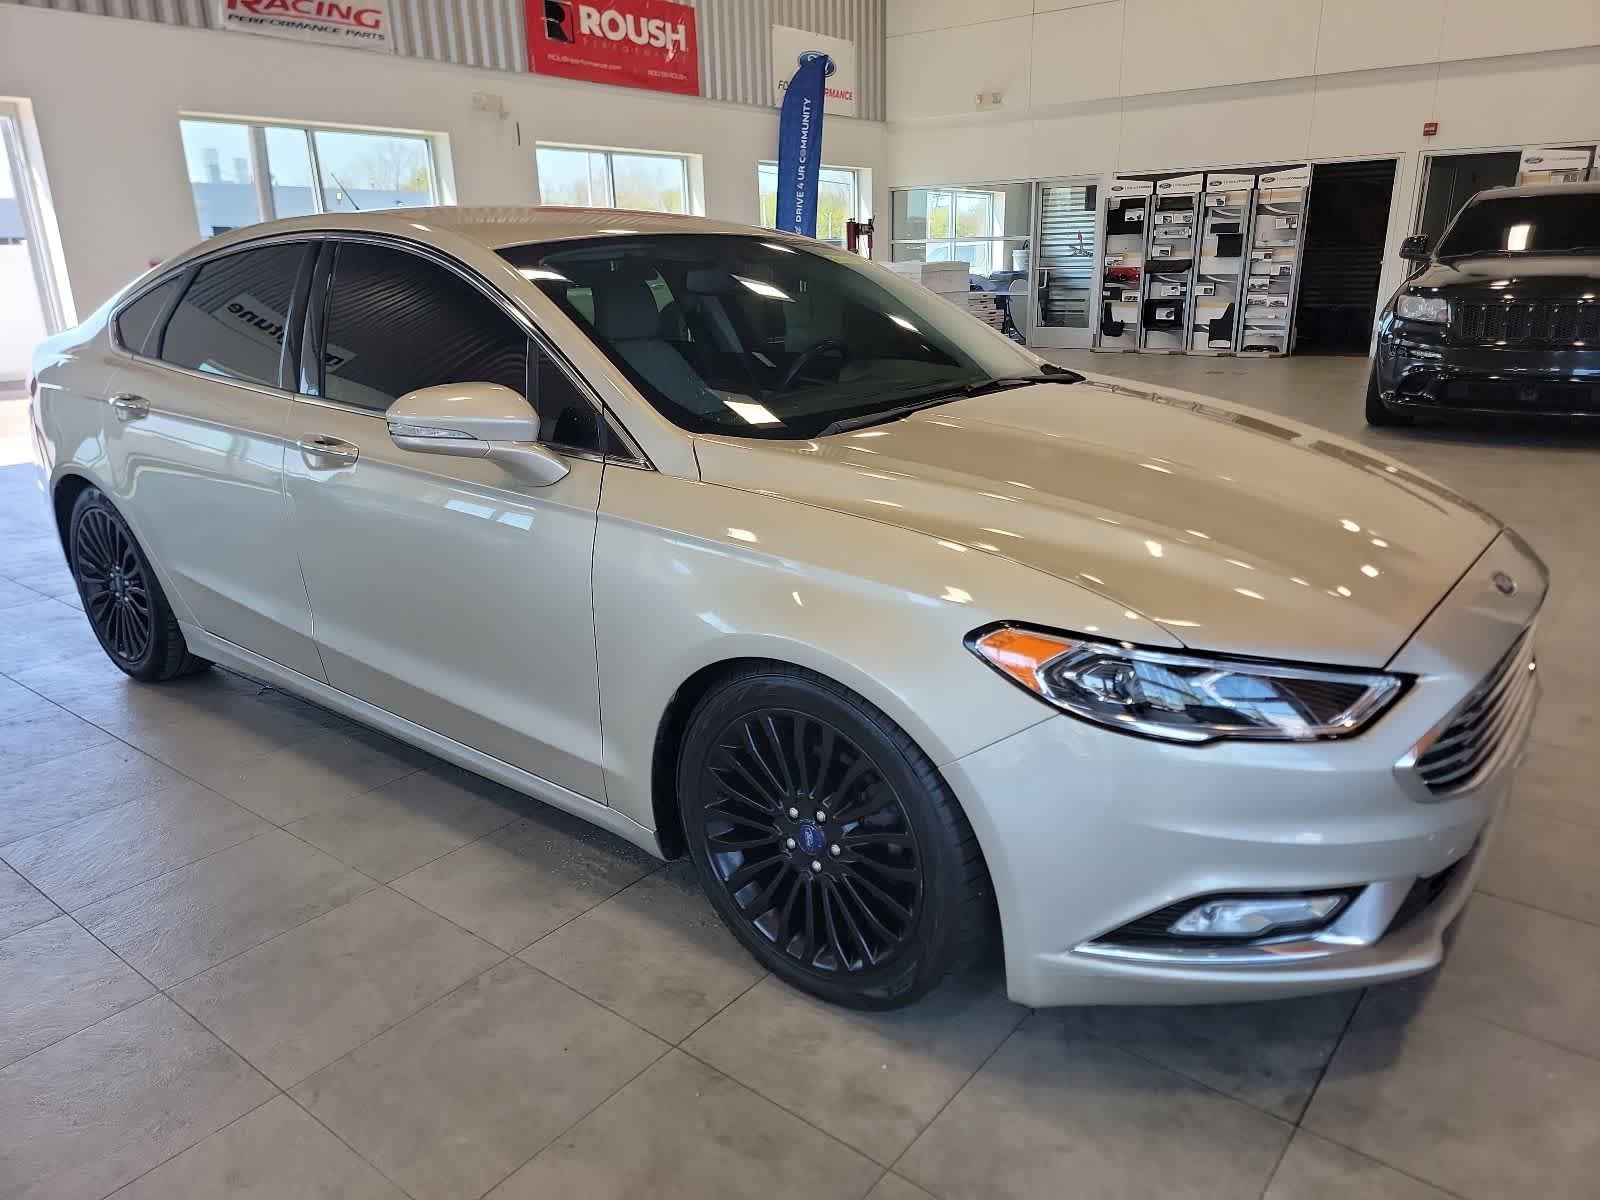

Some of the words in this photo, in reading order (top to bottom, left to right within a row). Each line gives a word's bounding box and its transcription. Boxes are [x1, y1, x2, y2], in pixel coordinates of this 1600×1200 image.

[228, 14, 342, 33] PERFORMANCE
[346, 30, 385, 41] PARTS
[579, 5, 687, 52] ROUSH
[824, 88, 853, 100] RMANCE
[800, 98, 811, 163] COMMUNITY
[797, 166, 805, 180] UR
[795, 192, 804, 222] DRIVE
